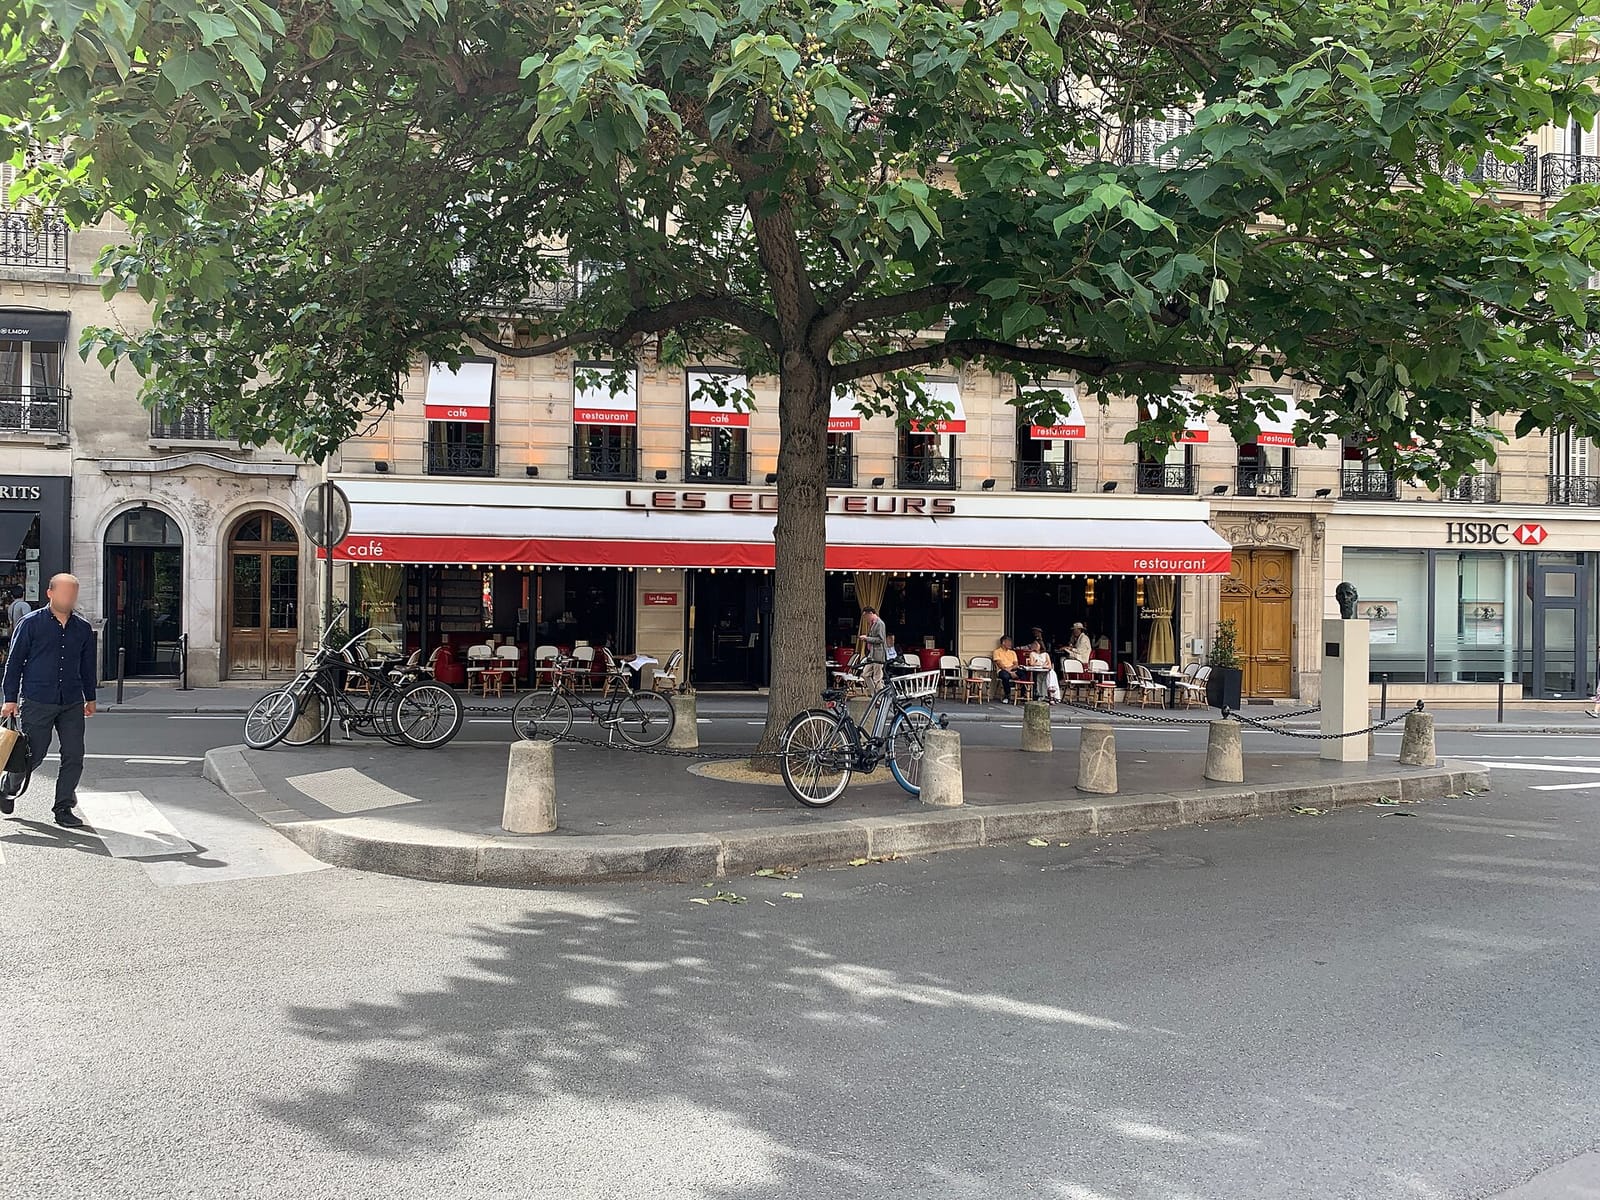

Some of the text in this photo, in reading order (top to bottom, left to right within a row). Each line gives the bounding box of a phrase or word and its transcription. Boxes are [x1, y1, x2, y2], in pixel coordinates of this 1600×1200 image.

[447, 408, 468, 417] café
[582, 412, 629, 421] restaurant
[710, 413, 730, 423] café
[934, 421, 947, 431] afé
[1263, 435, 1296, 444] restaura
[625, 490, 956, 514] LES EDTEURS
[1446, 522, 1509, 544] HSBC
[347, 540, 383, 556] café
[1133, 557, 1207, 569] restaurant
